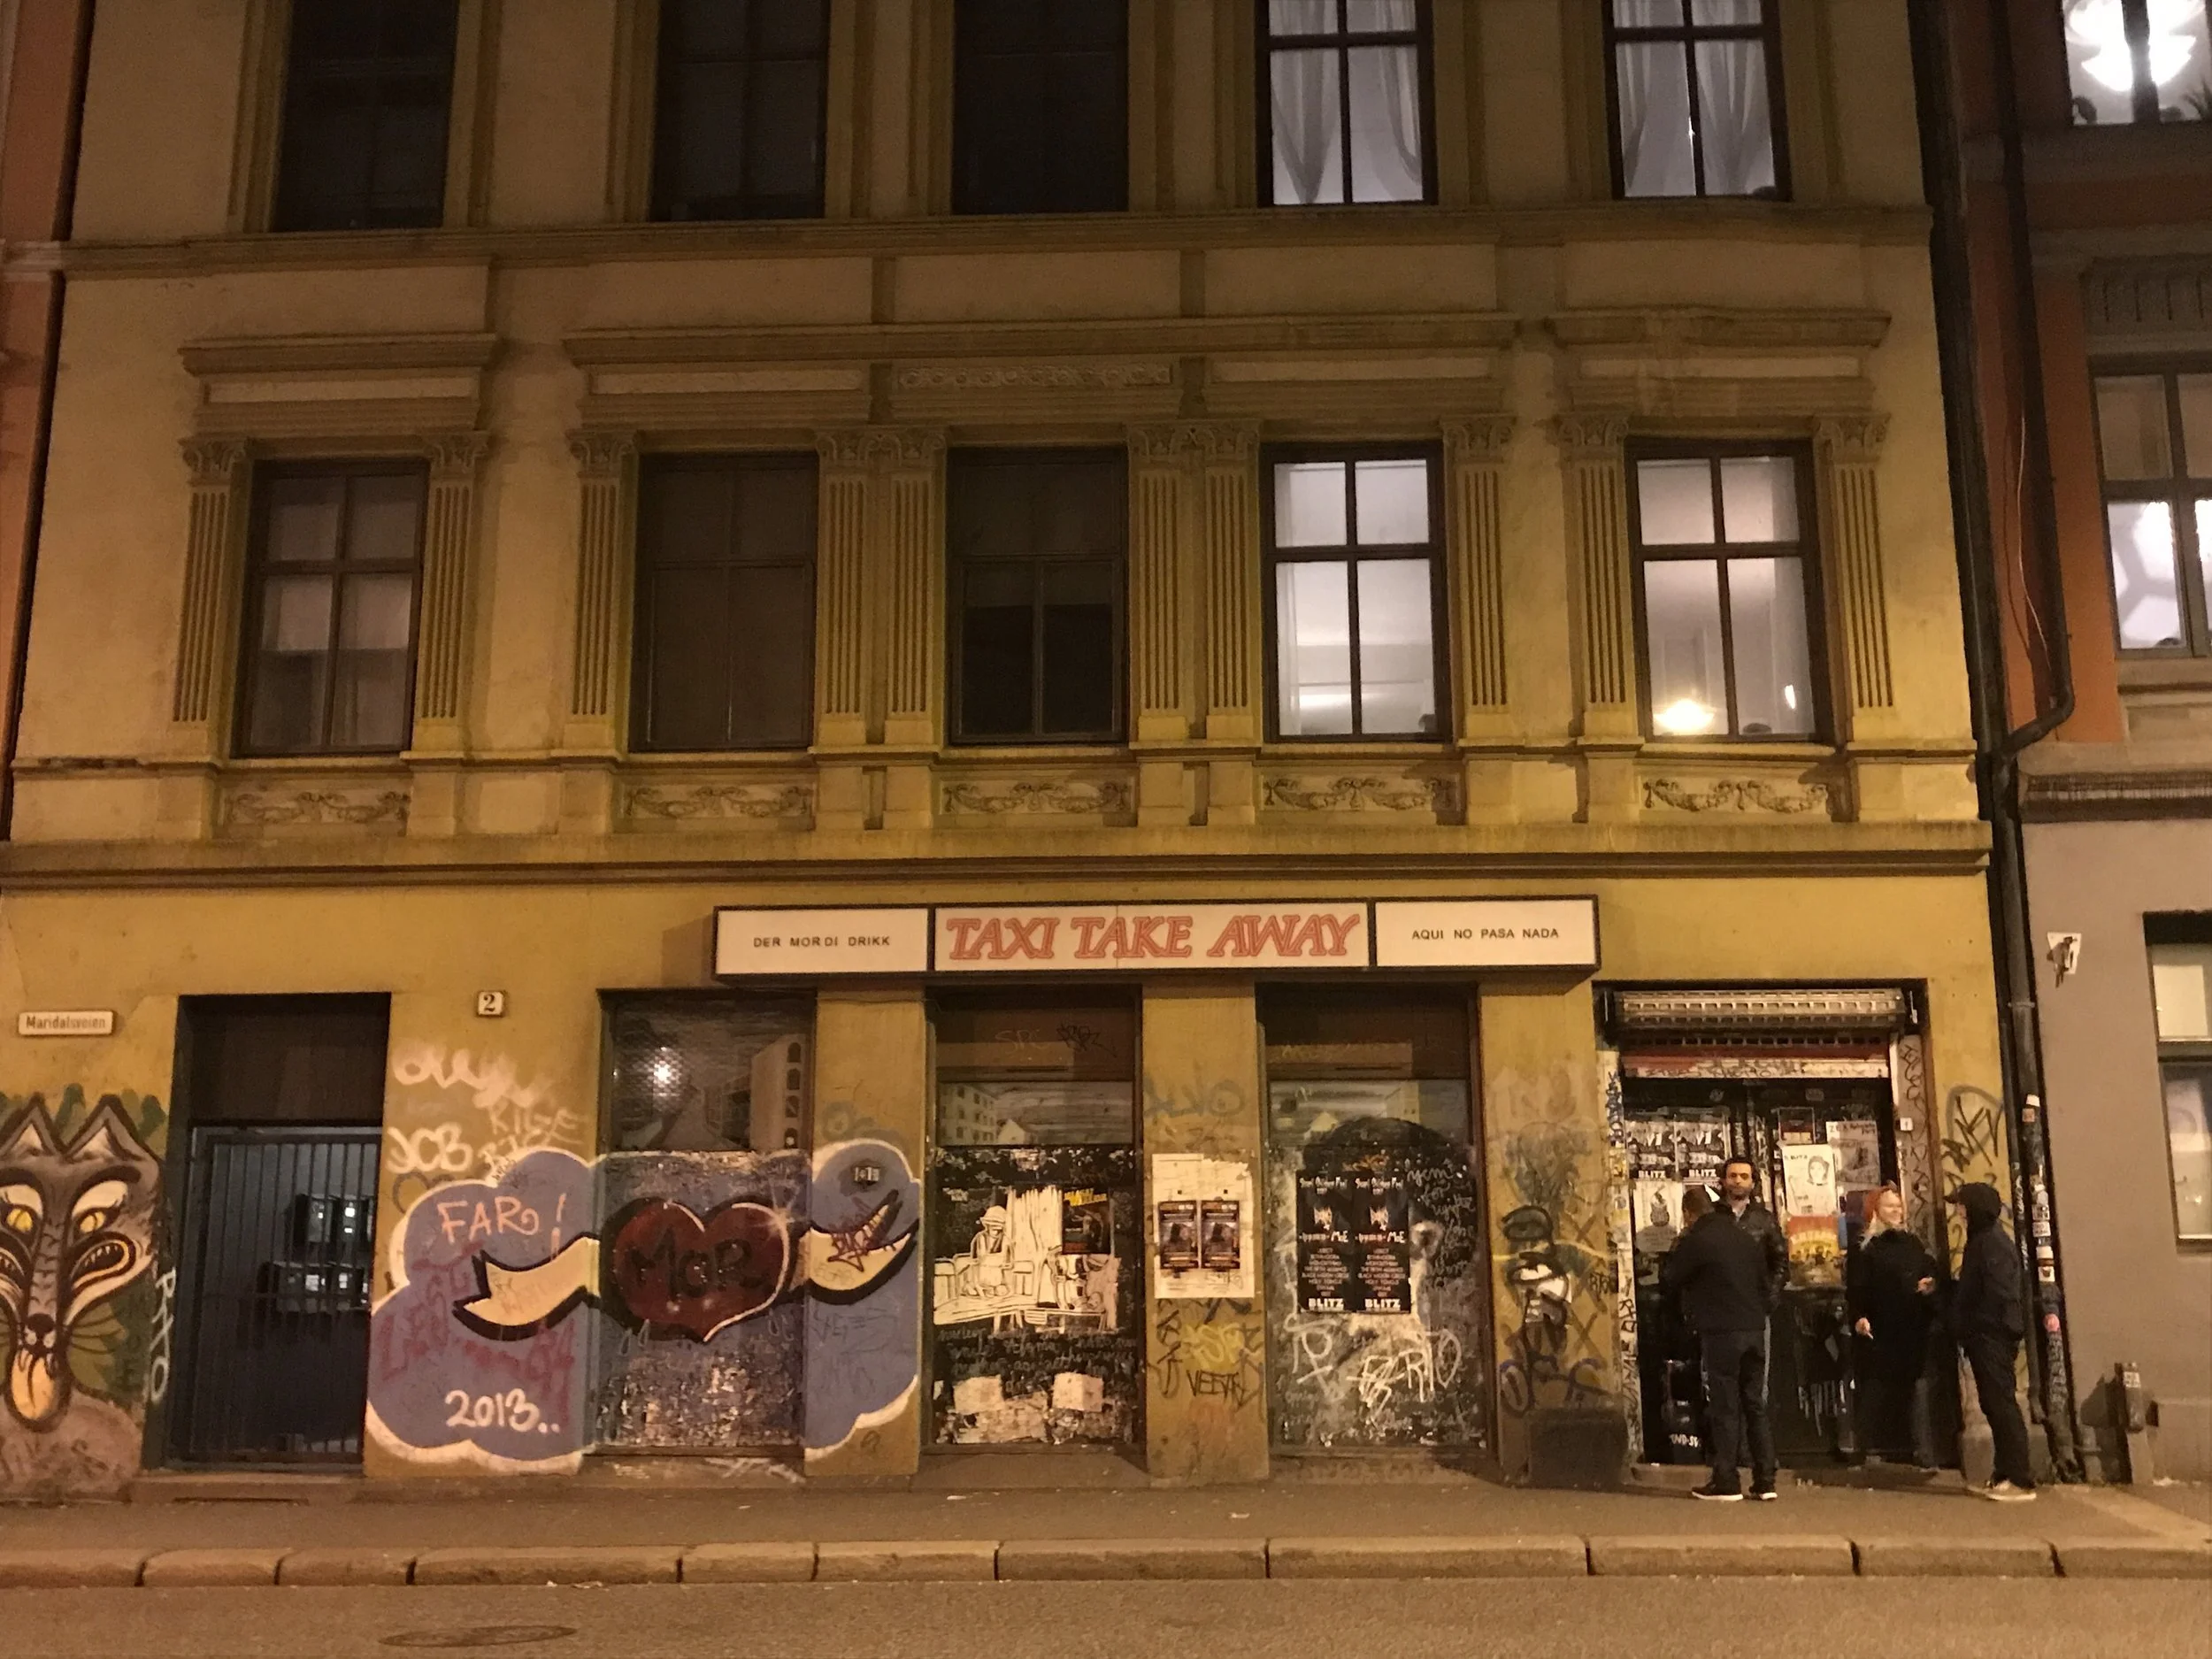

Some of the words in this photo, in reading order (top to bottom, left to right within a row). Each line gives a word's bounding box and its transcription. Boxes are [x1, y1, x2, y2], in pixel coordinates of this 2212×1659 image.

[946, 917, 1060, 960] TAXI
[1070, 915, 1193, 959] TAKE
[1206, 913, 1361, 957] AWAY
[1411, 929, 1444, 940] AQUI
[1454, 929, 1472, 939] NO
[1480, 928, 1515, 939] PASA
[1522, 928, 1559, 938] NADA
[753, 936, 781, 948] DER
[848, 935, 890, 947] DRIKK
[483, 994, 495, 1012] 2
[1638, 1170, 1665, 1179] BLITZ
[1688, 1169, 1717, 1178] BLITZ
[1308, 1297, 1344, 1309] BLITZ
[1364, 1298, 1401, 1310] BLITZ
